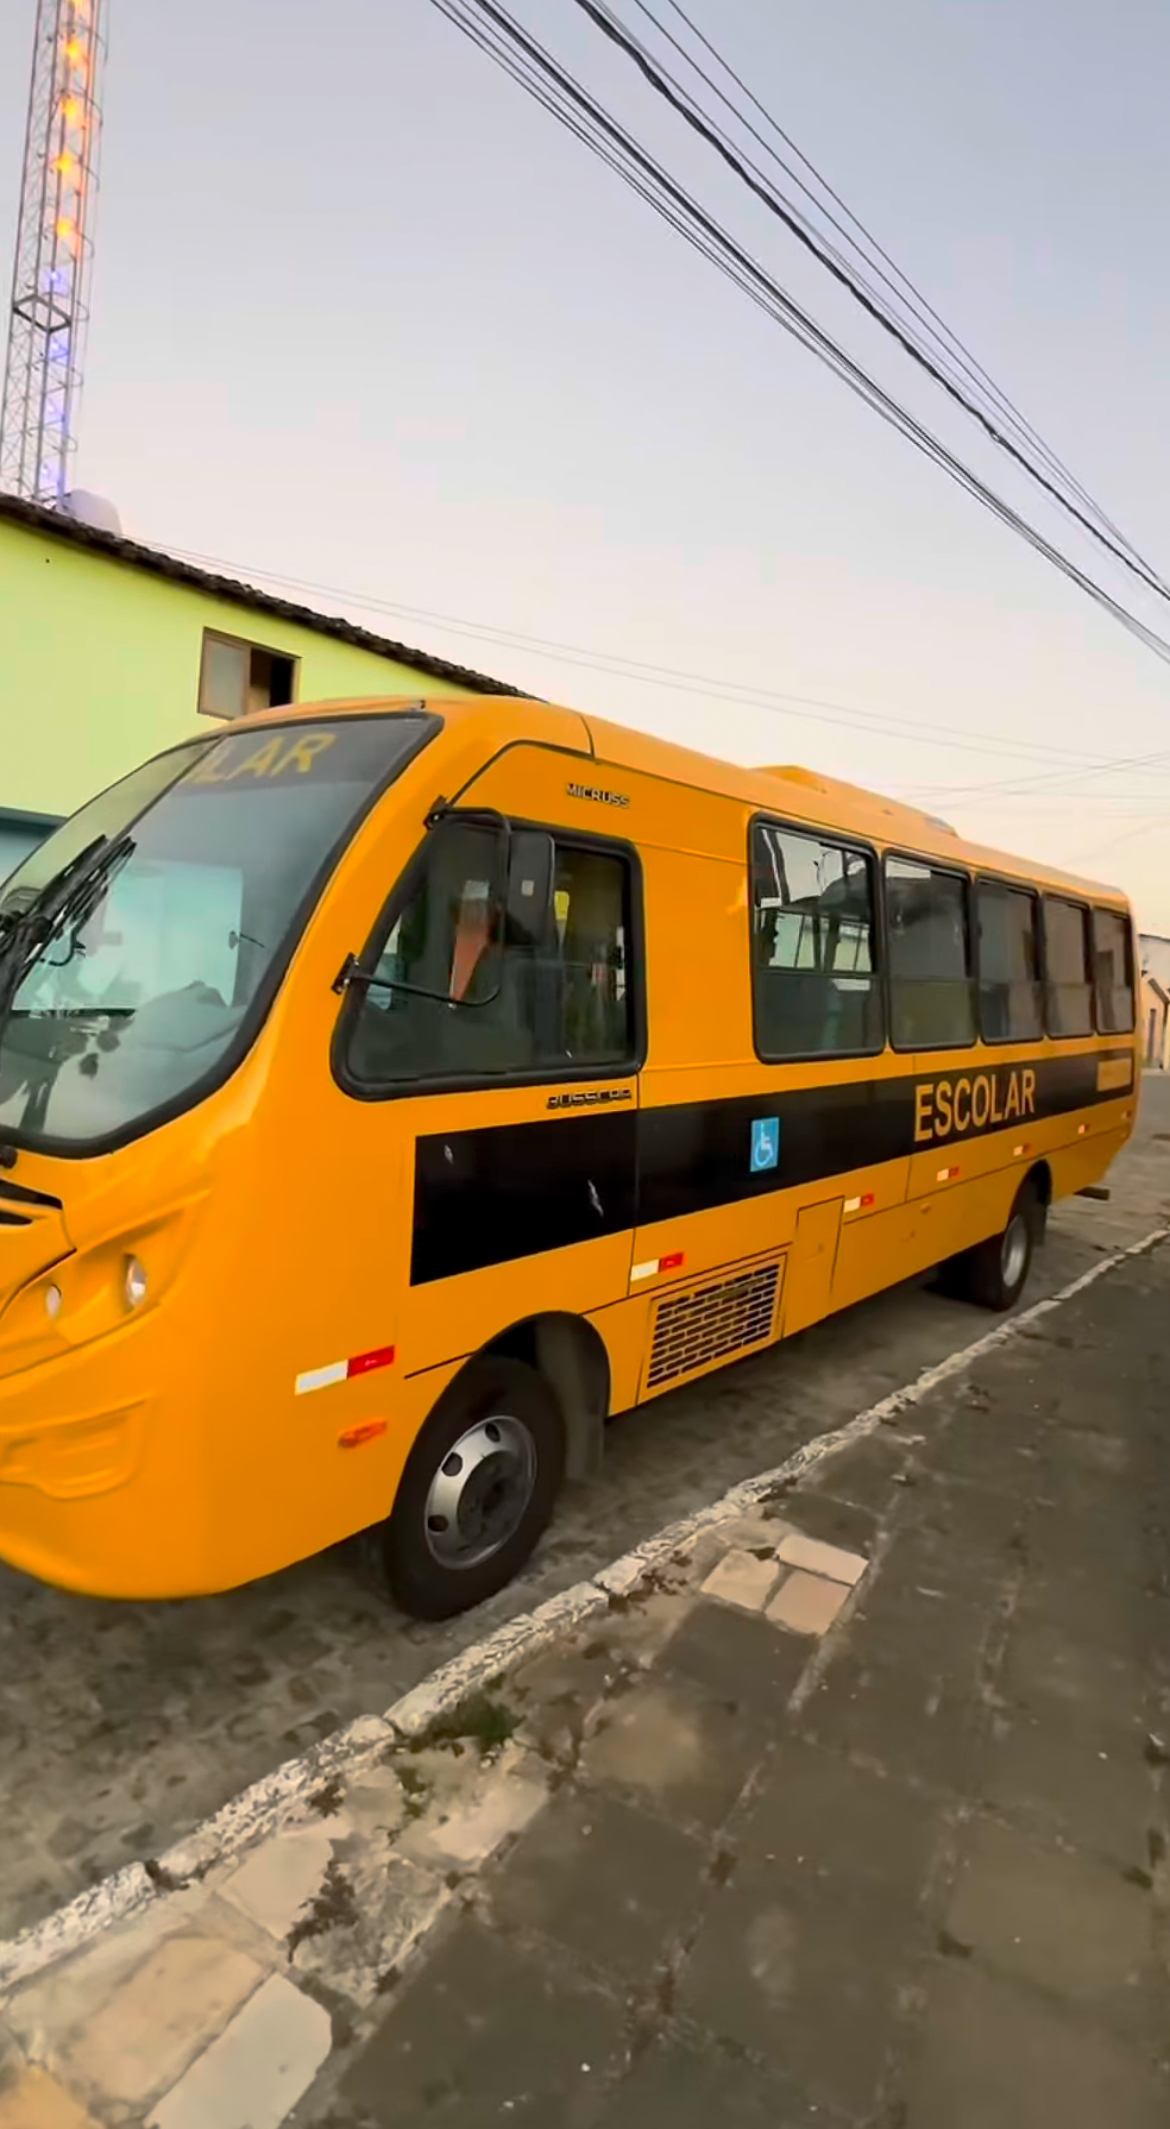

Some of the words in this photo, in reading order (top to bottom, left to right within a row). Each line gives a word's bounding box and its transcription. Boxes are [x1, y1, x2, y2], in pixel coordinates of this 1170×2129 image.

[191, 732, 337, 784] LAR
[566, 782, 631, 809] MICRUSS
[914, 1068, 1037, 1142] ESCOLAR
